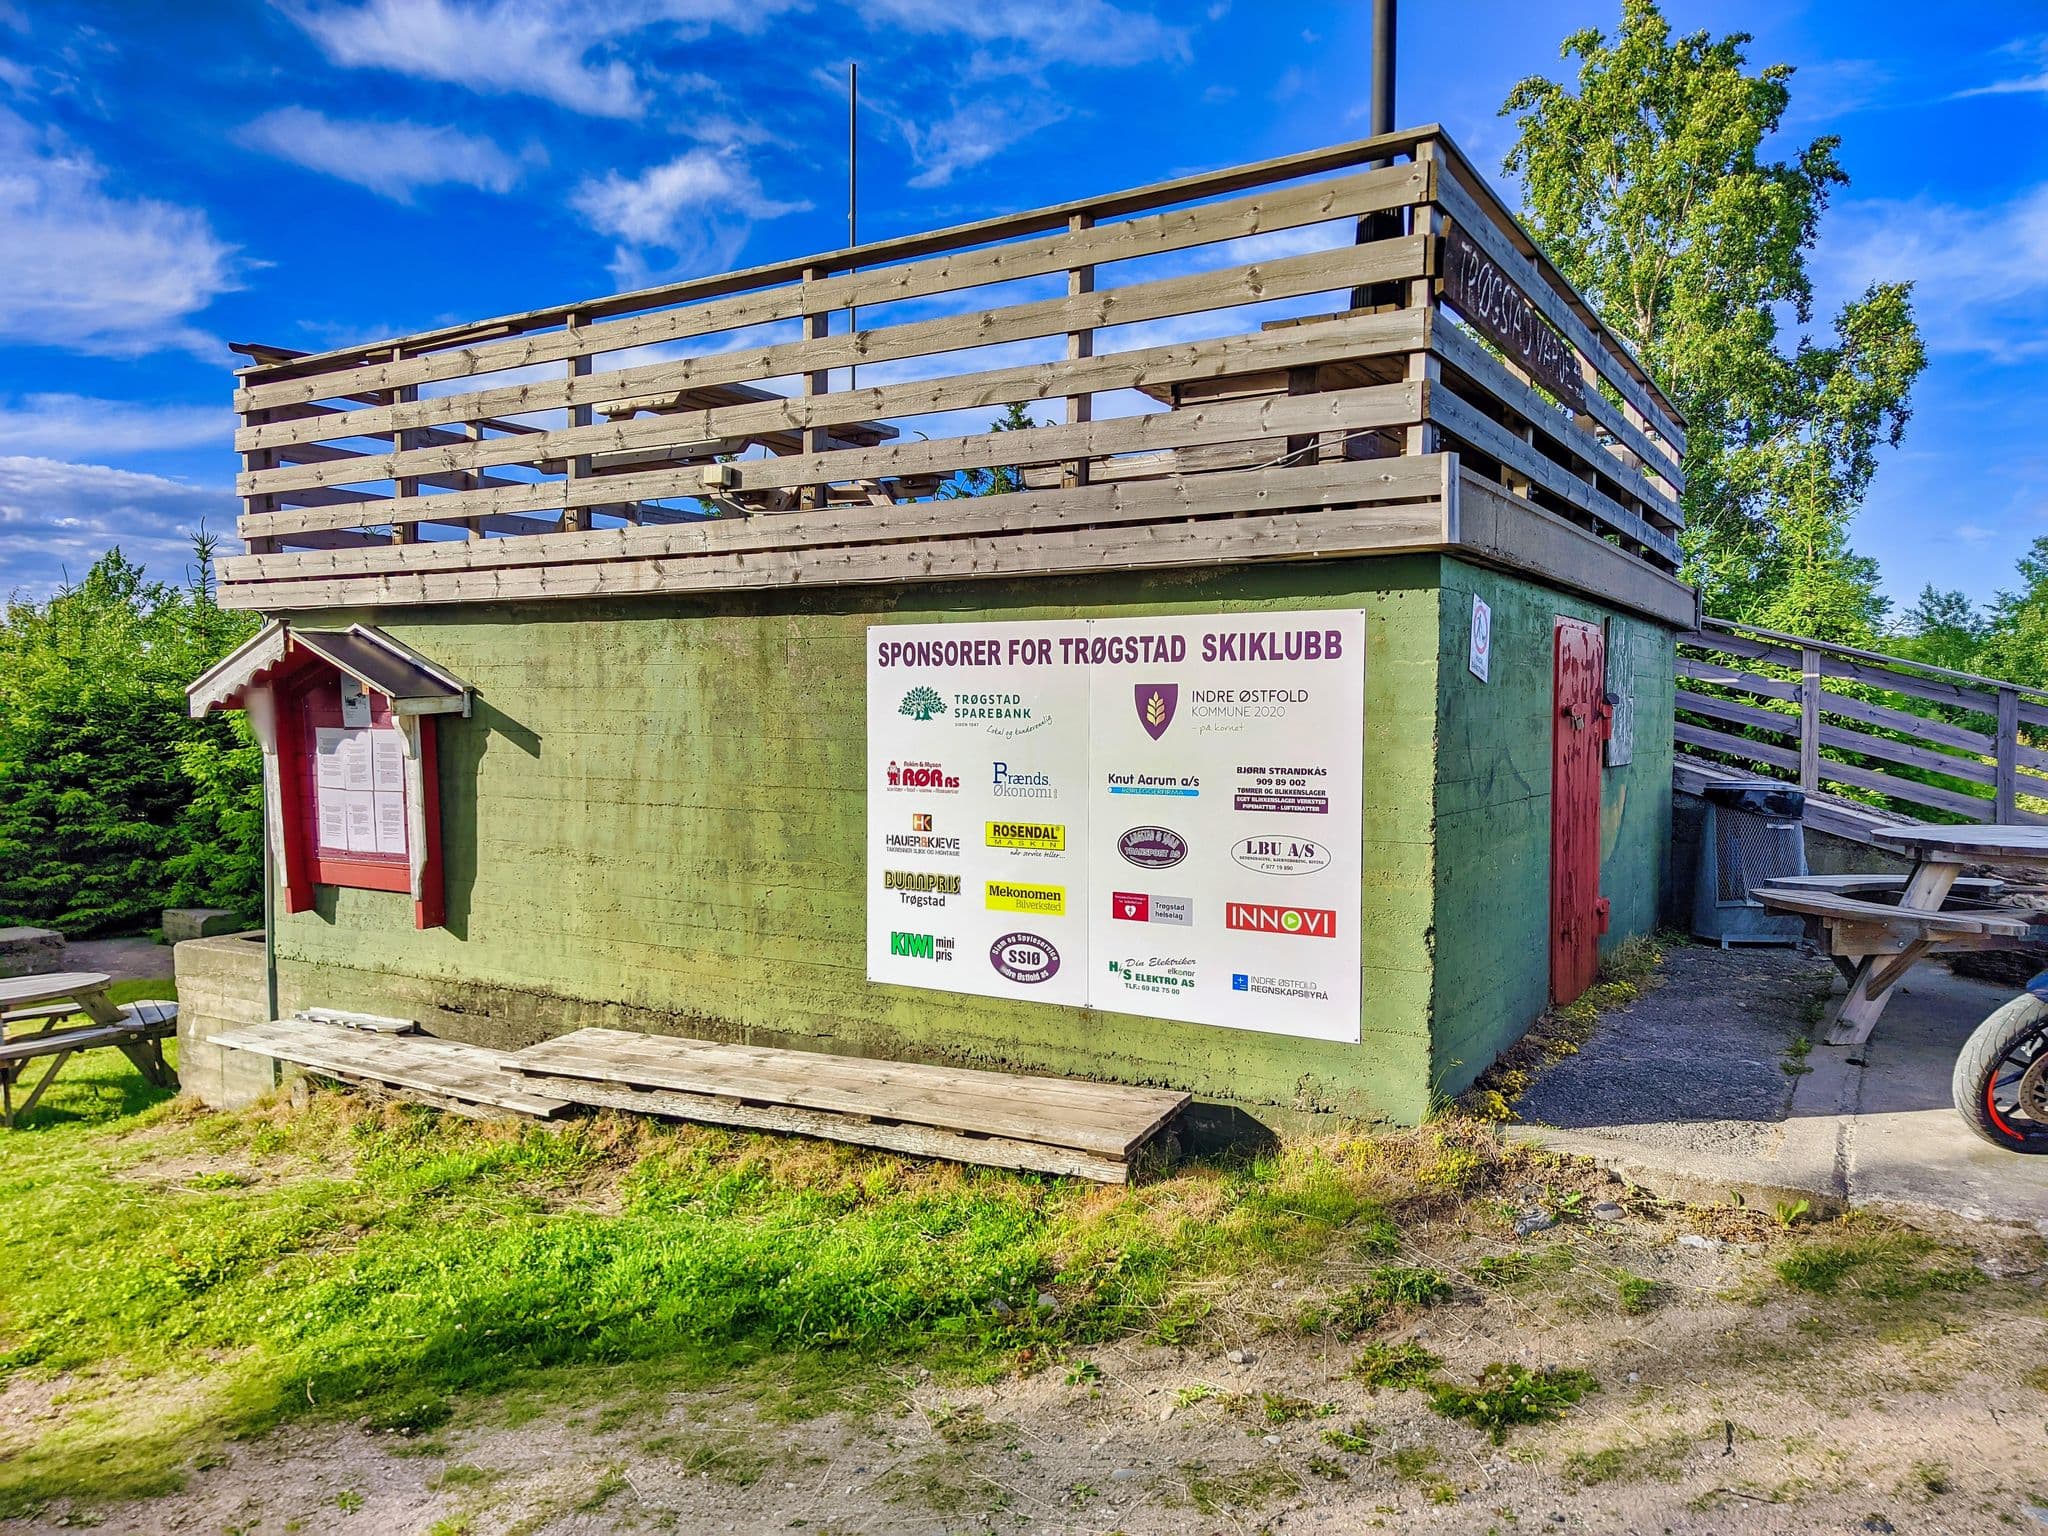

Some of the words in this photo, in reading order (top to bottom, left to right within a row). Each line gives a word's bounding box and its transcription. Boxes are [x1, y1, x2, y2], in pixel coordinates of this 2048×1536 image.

[878, 640, 1001, 667] SPONSORER
[1008, 638, 1052, 665] FOR
[1059, 634, 1186, 664] TRØGSTAD
[1201, 630, 1343, 662] SKIKLUBB
[954, 694, 1021, 705] TRØGSTAD
[1192, 690, 1235, 703] INDRE
[1239, 689, 1309, 703] ØSTFOLD
[954, 708, 1031, 719] SPAREBANK
[1192, 706, 1250, 718] KOMMUNE
[1253, 705, 1286, 718] 2020
[1214, 723, 1244, 733] kornet
[1006, 730, 1013, 740] og
[993, 761, 1049, 786] Brænds
[1237, 767, 1266, 775] BJØRN
[1268, 766, 1327, 776] STRANDKÅS
[903, 768, 943, 787] RØR
[945, 777, 960, 788] AS
[1108, 773, 1134, 784] Knut
[1138, 774, 1177, 786] Aarum
[1181, 775, 1200, 787] a/s
[1256, 778, 1273, 786] 909
[1275, 778, 1286, 786] 89
[1289, 779, 1306, 787] 002
[993, 781, 1053, 799] Økonomi
[993, 825, 1058, 839] ROSENDAL
[1246, 841, 1281, 856] LBU
[1288, 843, 1315, 858] A/S
[884, 870, 961, 895] BUNNPRIS
[989, 884, 1061, 901] Mekonomen
[900, 892, 946, 908] Trøgstad
[1015, 899, 1062, 912] Bilverksted
[1155, 902, 1185, 911] Trøgstad
[1155, 911, 1184, 920] helselag
[1232, 905, 1329, 934] INNOVI
[891, 932, 934, 960] KIWI
[935, 937, 955, 949] mini
[935, 949, 953, 962] pris
[1008, 949, 1041, 966] SSIØ
[1125, 958, 1144, 967] Din
[1149, 957, 1196, 967] Elektriker
[1168, 968, 1196, 977] elkonor
[1135, 974, 1178, 986] ELEKTRO
[1181, 979, 1195, 988] AS
[1251, 975, 1276, 986] INDRE
